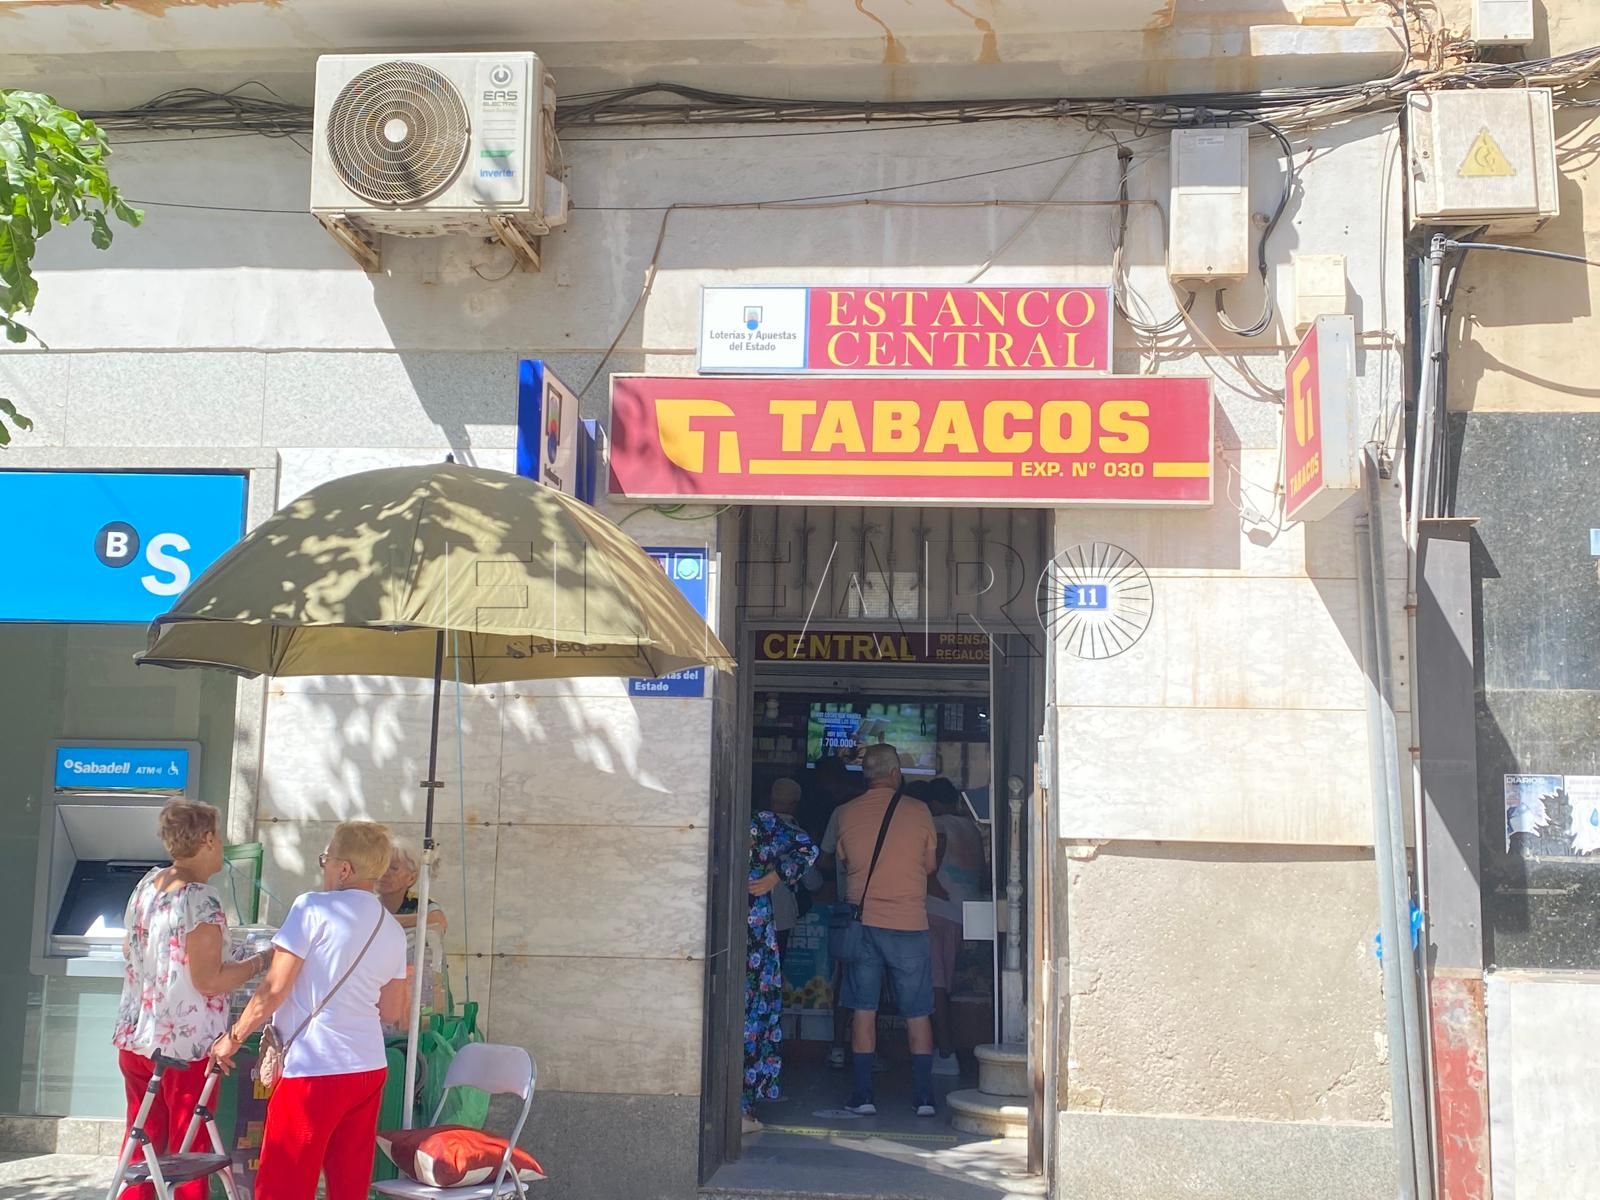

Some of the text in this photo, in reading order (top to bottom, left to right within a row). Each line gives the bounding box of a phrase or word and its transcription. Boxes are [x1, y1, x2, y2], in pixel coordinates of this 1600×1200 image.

[483, 91, 518, 100] EAS
[826, 290, 1096, 328] ESTANCO
[748, 333, 752, 341] y
[755, 331, 797, 341] Apuestas
[729, 342, 776, 351] del Estado
[827, 331, 1095, 368] CENTRAL
[769, 399, 1150, 454] TABACOS
[1021, 461, 1064, 477] EXP.
[1104, 462, 1144, 477] 030
[1290, 452, 1320, 497] TABACOS
[1077, 588, 1098, 606] 11
[762, 633, 988, 660] CENTRAL PRENSA
[936, 649, 990, 660] REGALOS
[635, 681, 669, 691] Estado
[73, 761, 155, 775] Sabadell ATM
